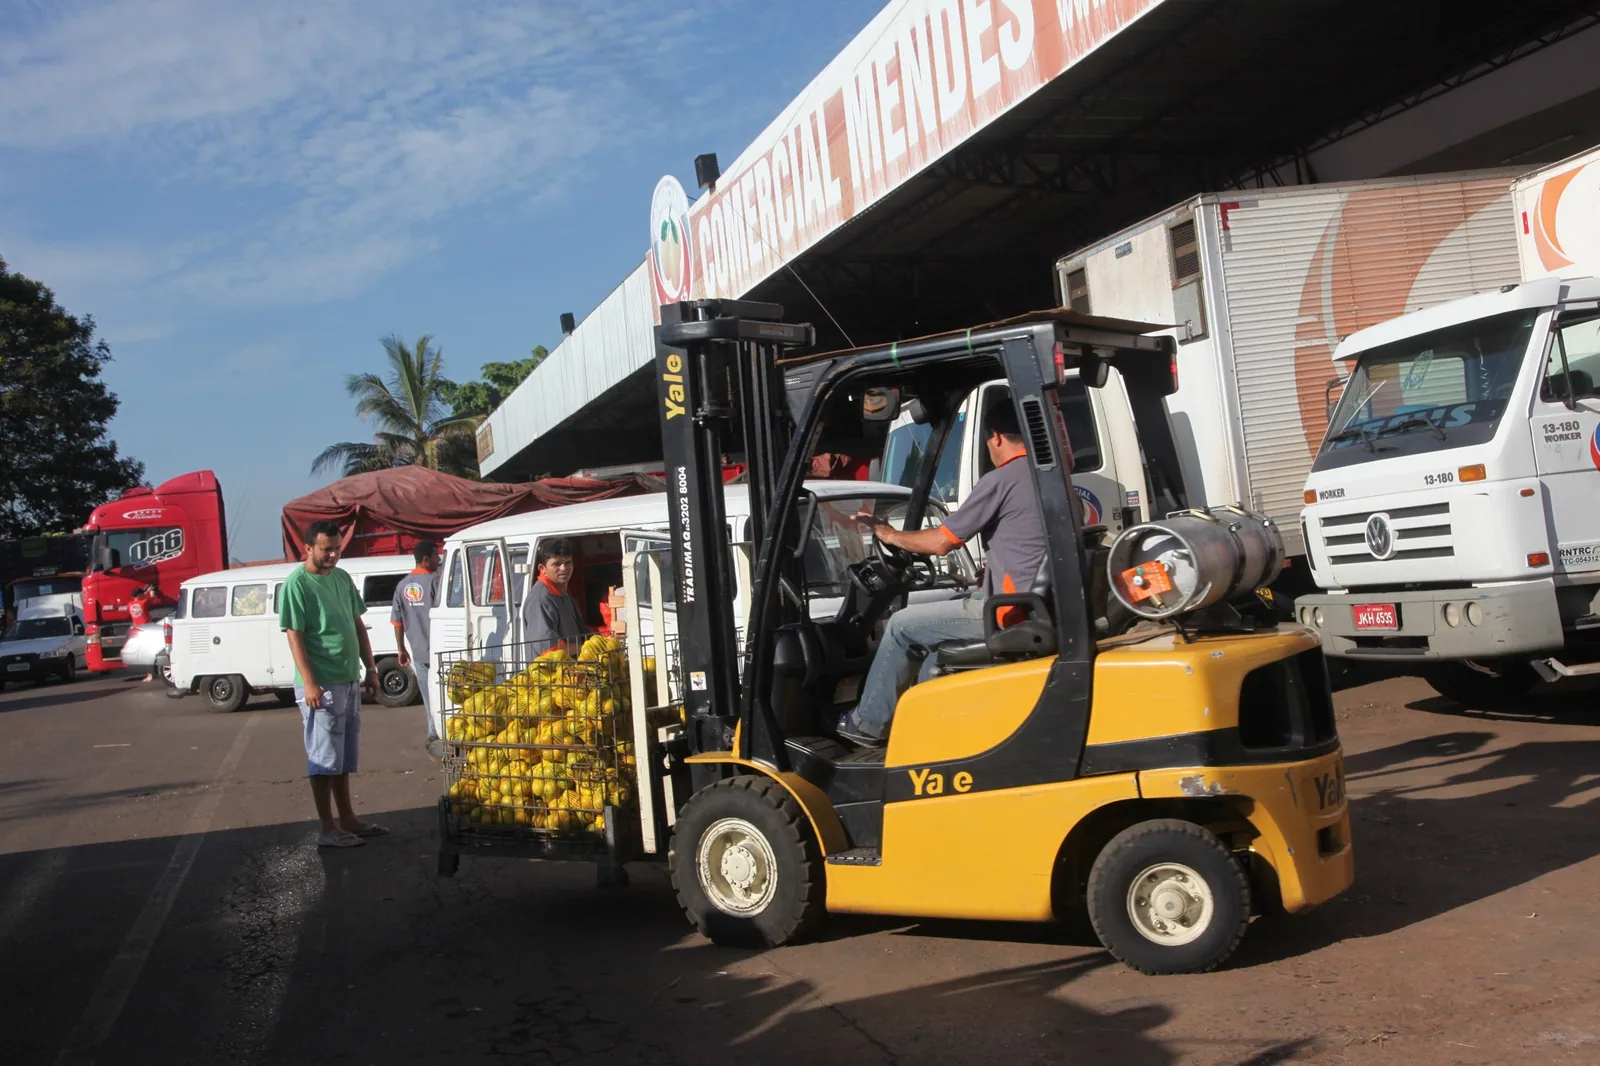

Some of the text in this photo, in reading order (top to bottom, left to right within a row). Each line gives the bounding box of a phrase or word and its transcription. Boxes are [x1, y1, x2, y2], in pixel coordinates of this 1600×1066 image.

[699, 102, 842, 298] COMERCIAL
[841, 0, 1035, 190] MENDES
[663, 354, 686, 420] Yale
[1542, 421, 1580, 434] 13-180
[1544, 432, 1582, 443] WORKER
[678, 466, 688, 494] 8004
[1424, 472, 1454, 485] 13-180
[1319, 488, 1345, 500] WORKER
[680, 496, 690, 524] 3202
[129, 528, 183, 564] 066
[1559, 546, 1591, 557] RNTRC
[683, 531, 695, 603] TRADIMAQ
[1357, 612, 1393, 625] JKH 6535
[908, 768, 974, 796] Yae
